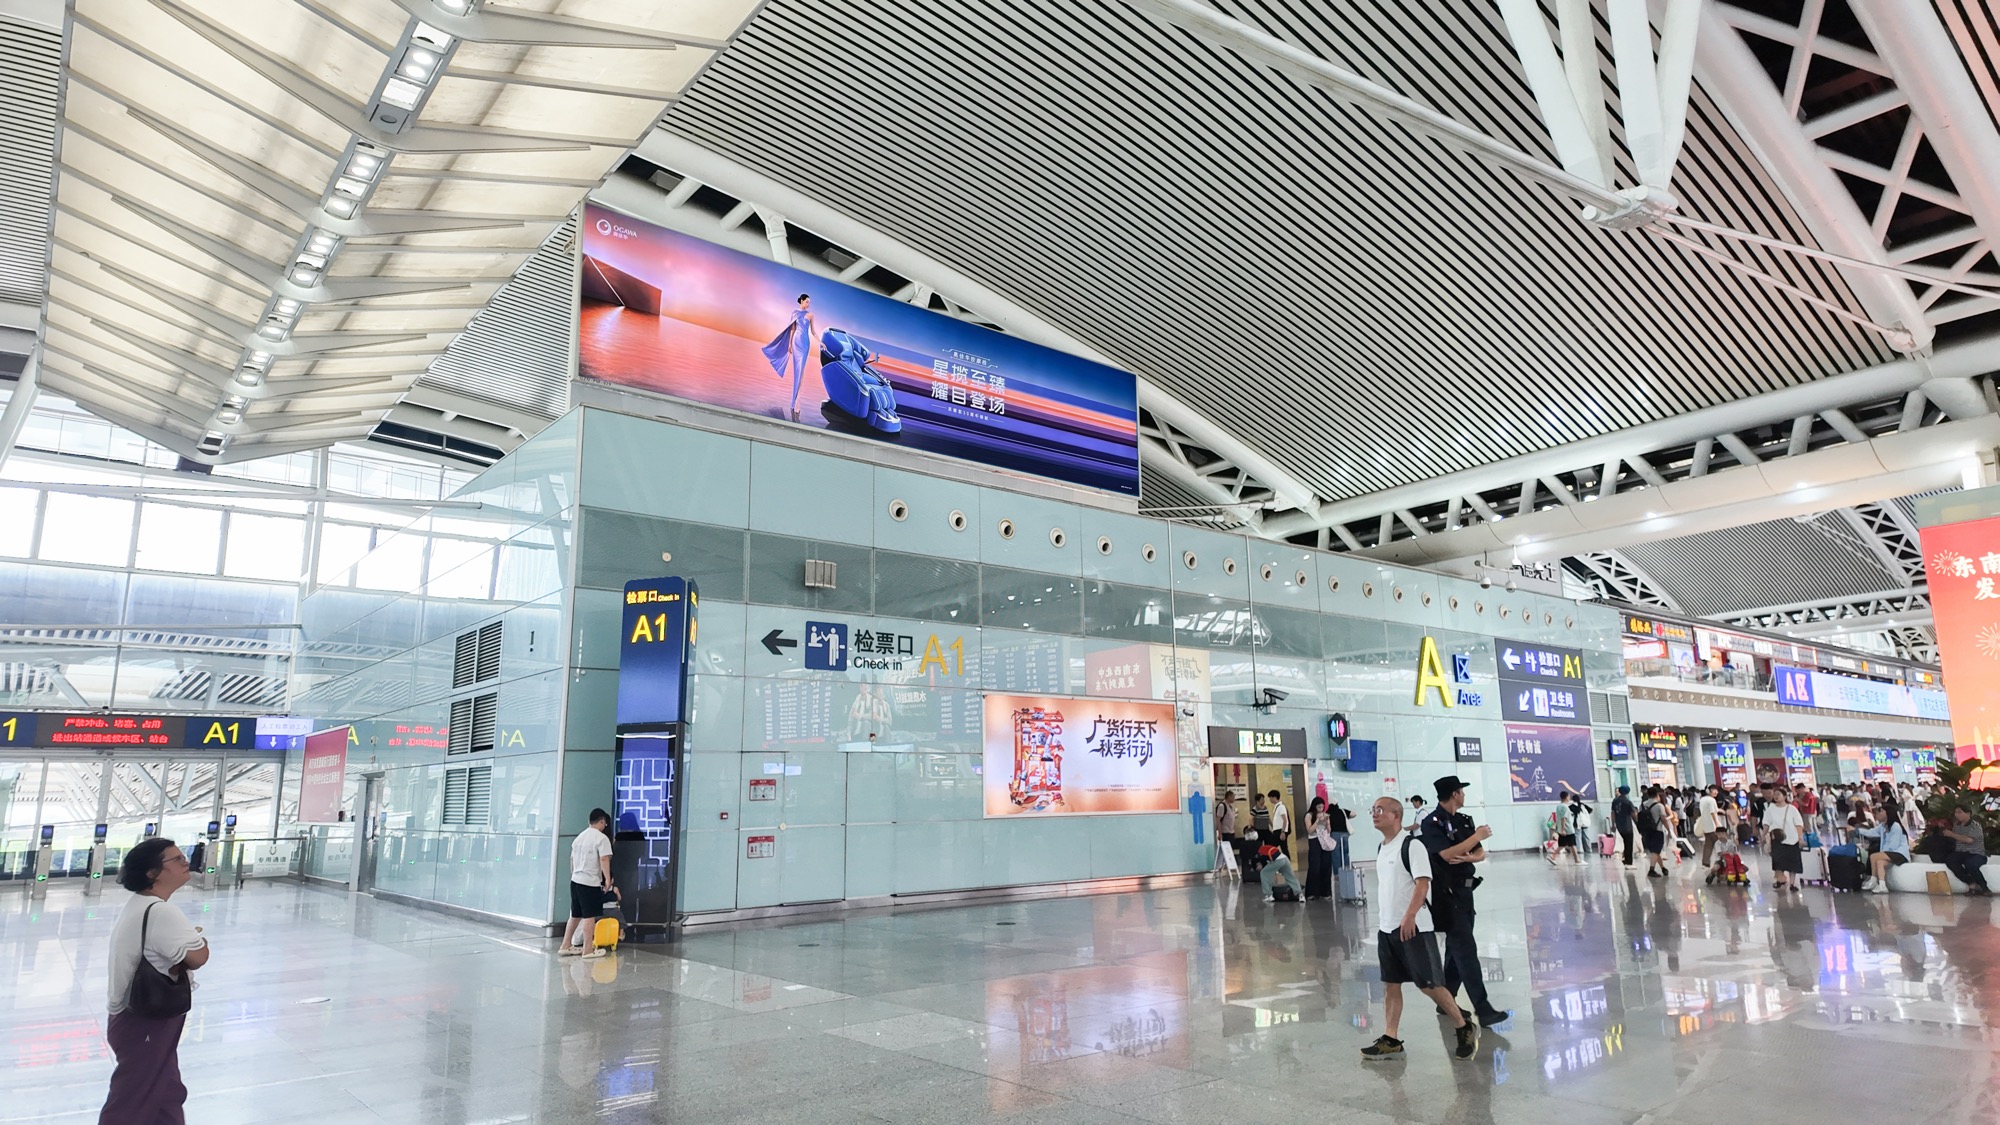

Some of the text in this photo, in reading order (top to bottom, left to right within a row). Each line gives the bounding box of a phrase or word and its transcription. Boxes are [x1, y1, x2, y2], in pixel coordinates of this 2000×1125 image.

[613, 225, 638, 238] OGAWA
[932, 359, 1006, 395] 星揽至臻
[931, 381, 1005, 415] 耀目登场
[626, 590, 658, 605] 检票口
[1974, 577, 2000, 601] 发
[631, 612, 667, 644] A1
[854, 628, 914, 656] 检票口
[918, 633, 965, 677] A1
[853, 656, 903, 671] Check in
[1414, 635, 1455, 708] A
[1452, 653, 1473, 684] 区
[1539, 650, 1562, 668] 检票口
[1563, 653, 1582, 680] A1
[1457, 688, 1482, 706] Area
[1549, 690, 1574, 708] 卫生间
[203, 721, 240, 744] A1
[1085, 713, 1158, 745] 广货行天下
[1255, 732, 1282, 746] 卫生间
[1088, 738, 1153, 768] 秋季行动
